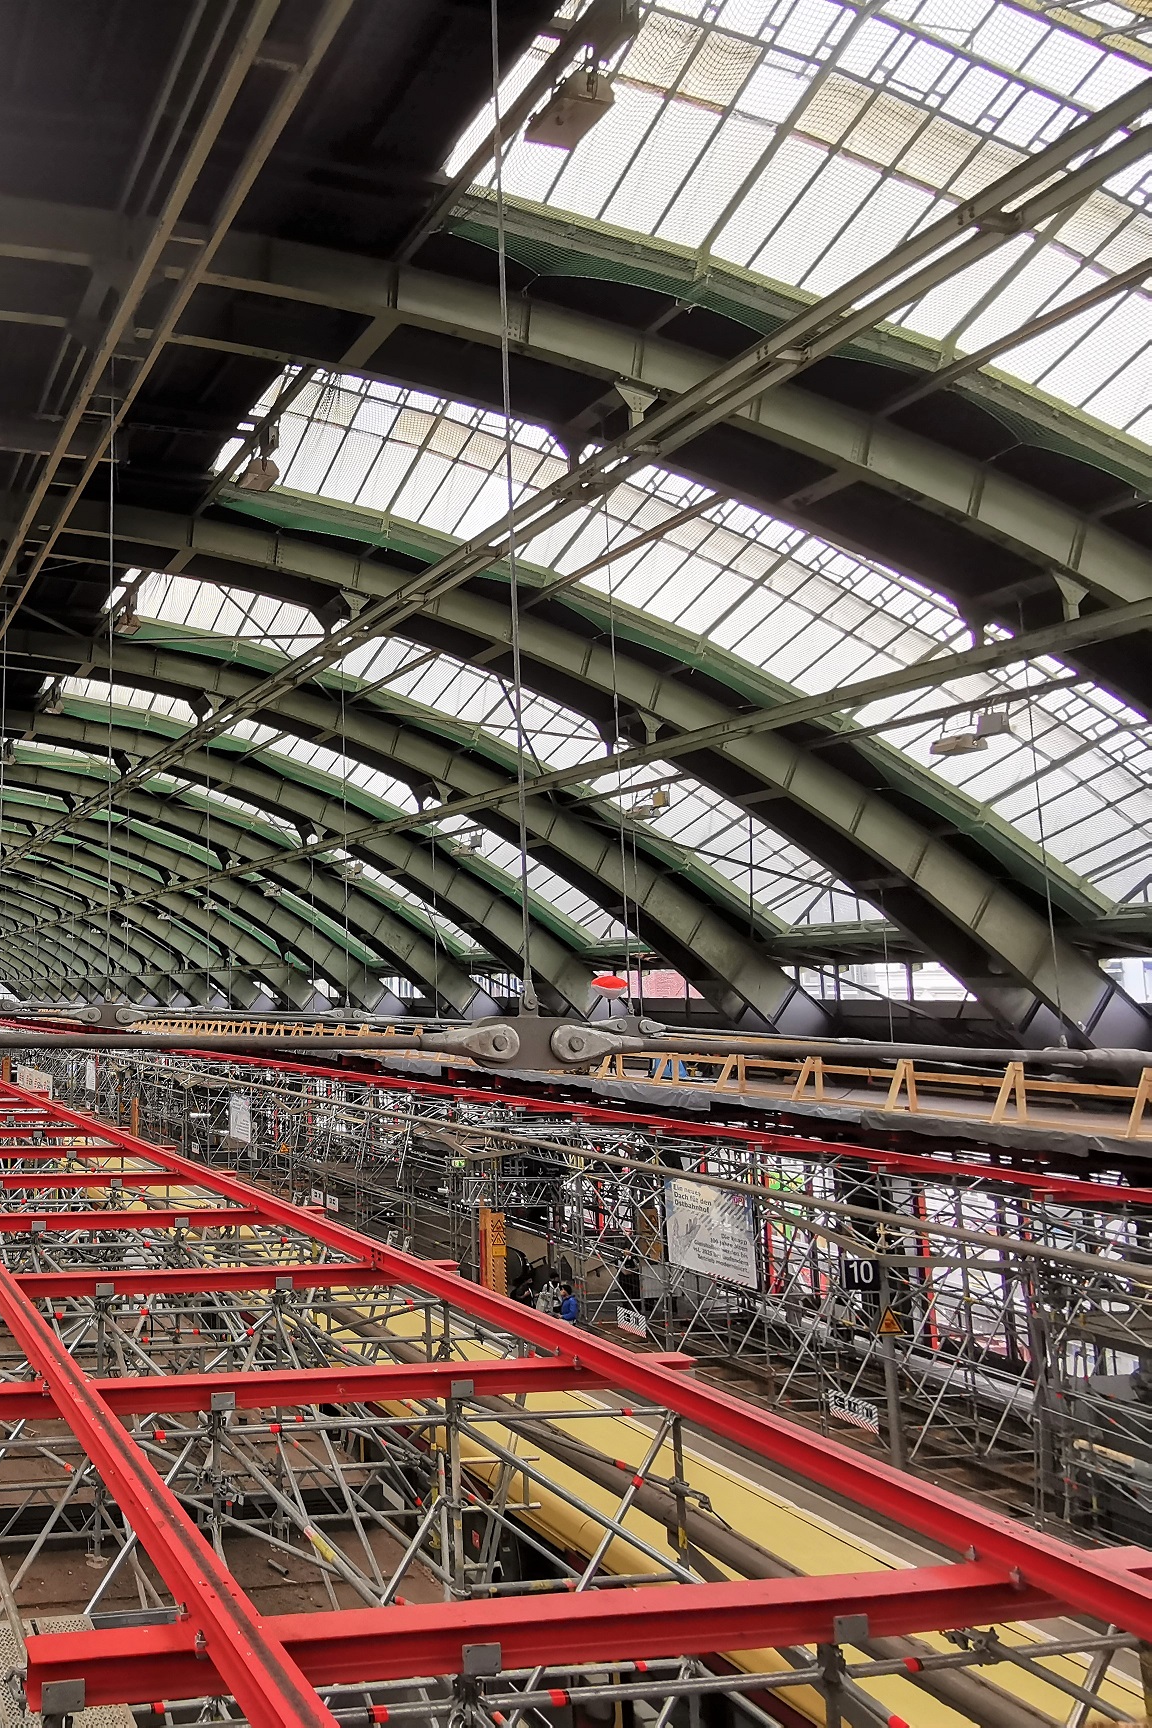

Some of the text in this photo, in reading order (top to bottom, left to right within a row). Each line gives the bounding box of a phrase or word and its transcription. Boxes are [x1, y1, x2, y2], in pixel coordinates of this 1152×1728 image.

[673, 1191, 689, 1201] Dach
[699, 1198, 712, 1207] den
[674, 1199, 710, 1214] Ostbahnhof
[849, 1260, 874, 1284] 10
